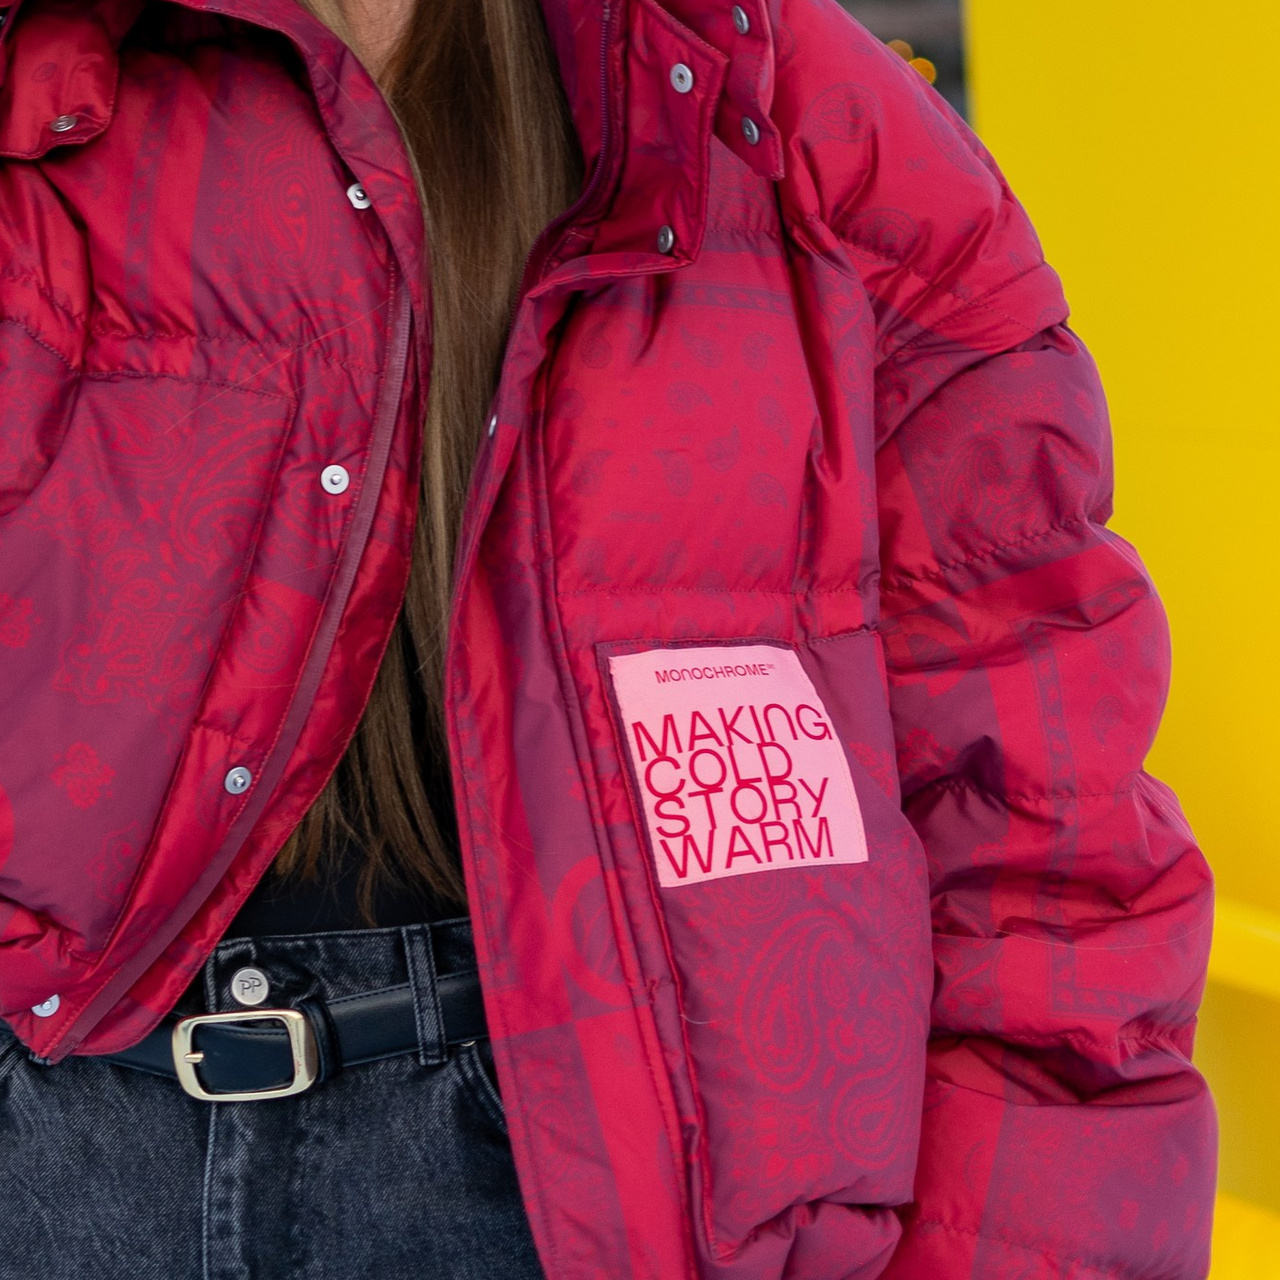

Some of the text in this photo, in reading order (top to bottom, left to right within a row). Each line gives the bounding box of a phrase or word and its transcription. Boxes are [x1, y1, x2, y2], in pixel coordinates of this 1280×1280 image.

[631, 703, 833, 762] MAKING
[644, 742, 793, 799] COLD
[654, 777, 829, 838] STORY
[660, 817, 834, 879] WARM
